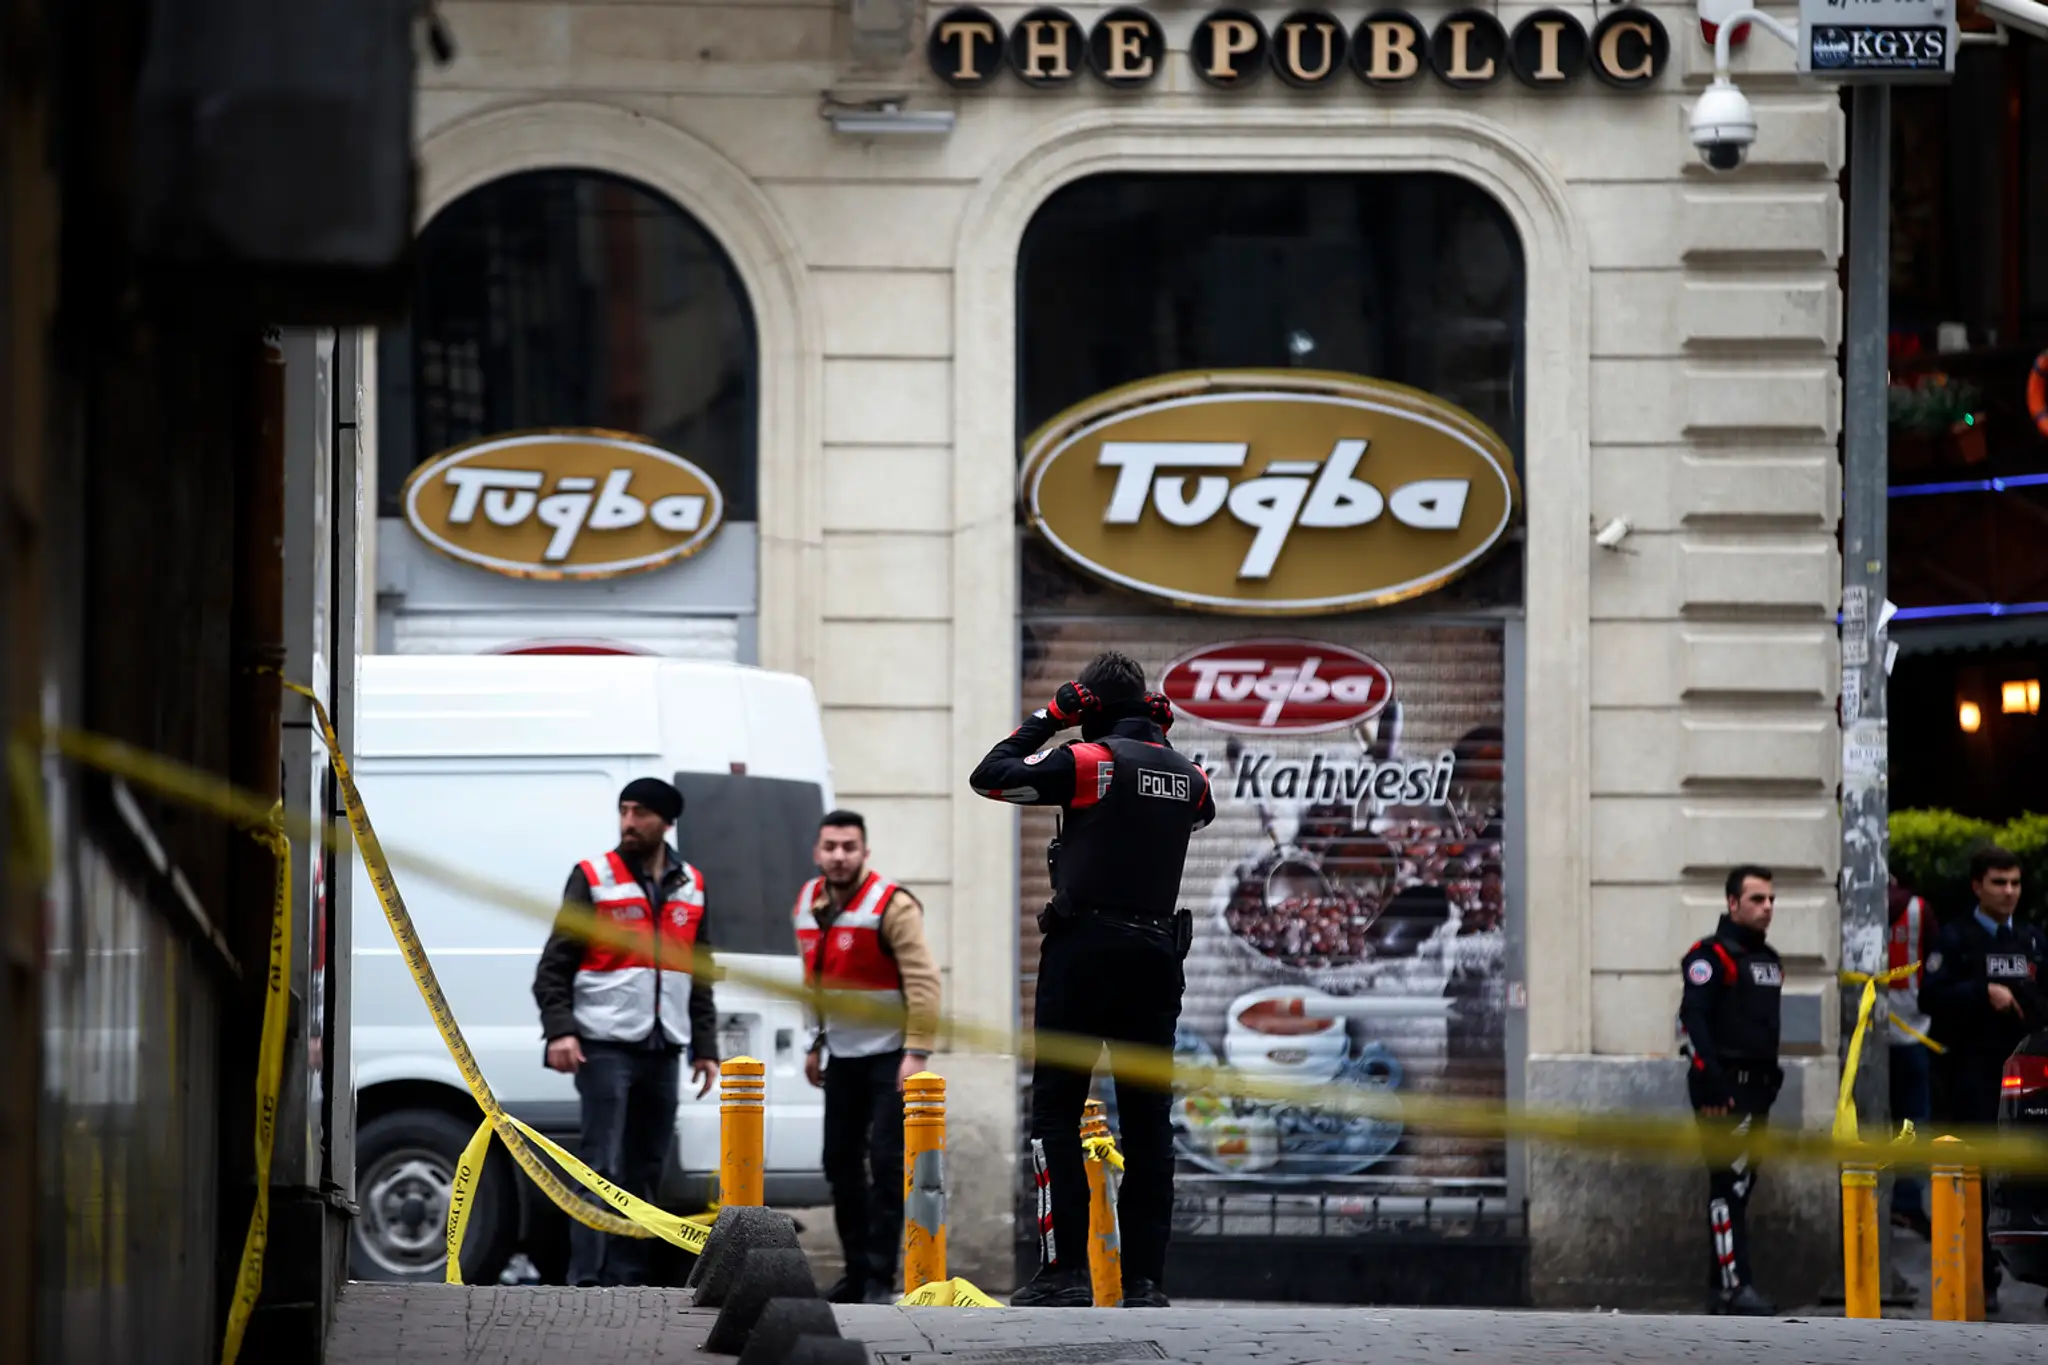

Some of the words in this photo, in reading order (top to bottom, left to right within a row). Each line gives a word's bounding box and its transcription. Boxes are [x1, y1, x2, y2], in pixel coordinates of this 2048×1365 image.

[939, 20, 1153, 80] THE
[1208, 20, 1653, 81] PUBLIC
[1851, 29, 1944, 58] KGYS
[1233, 751, 1454, 802] Kahvesi
